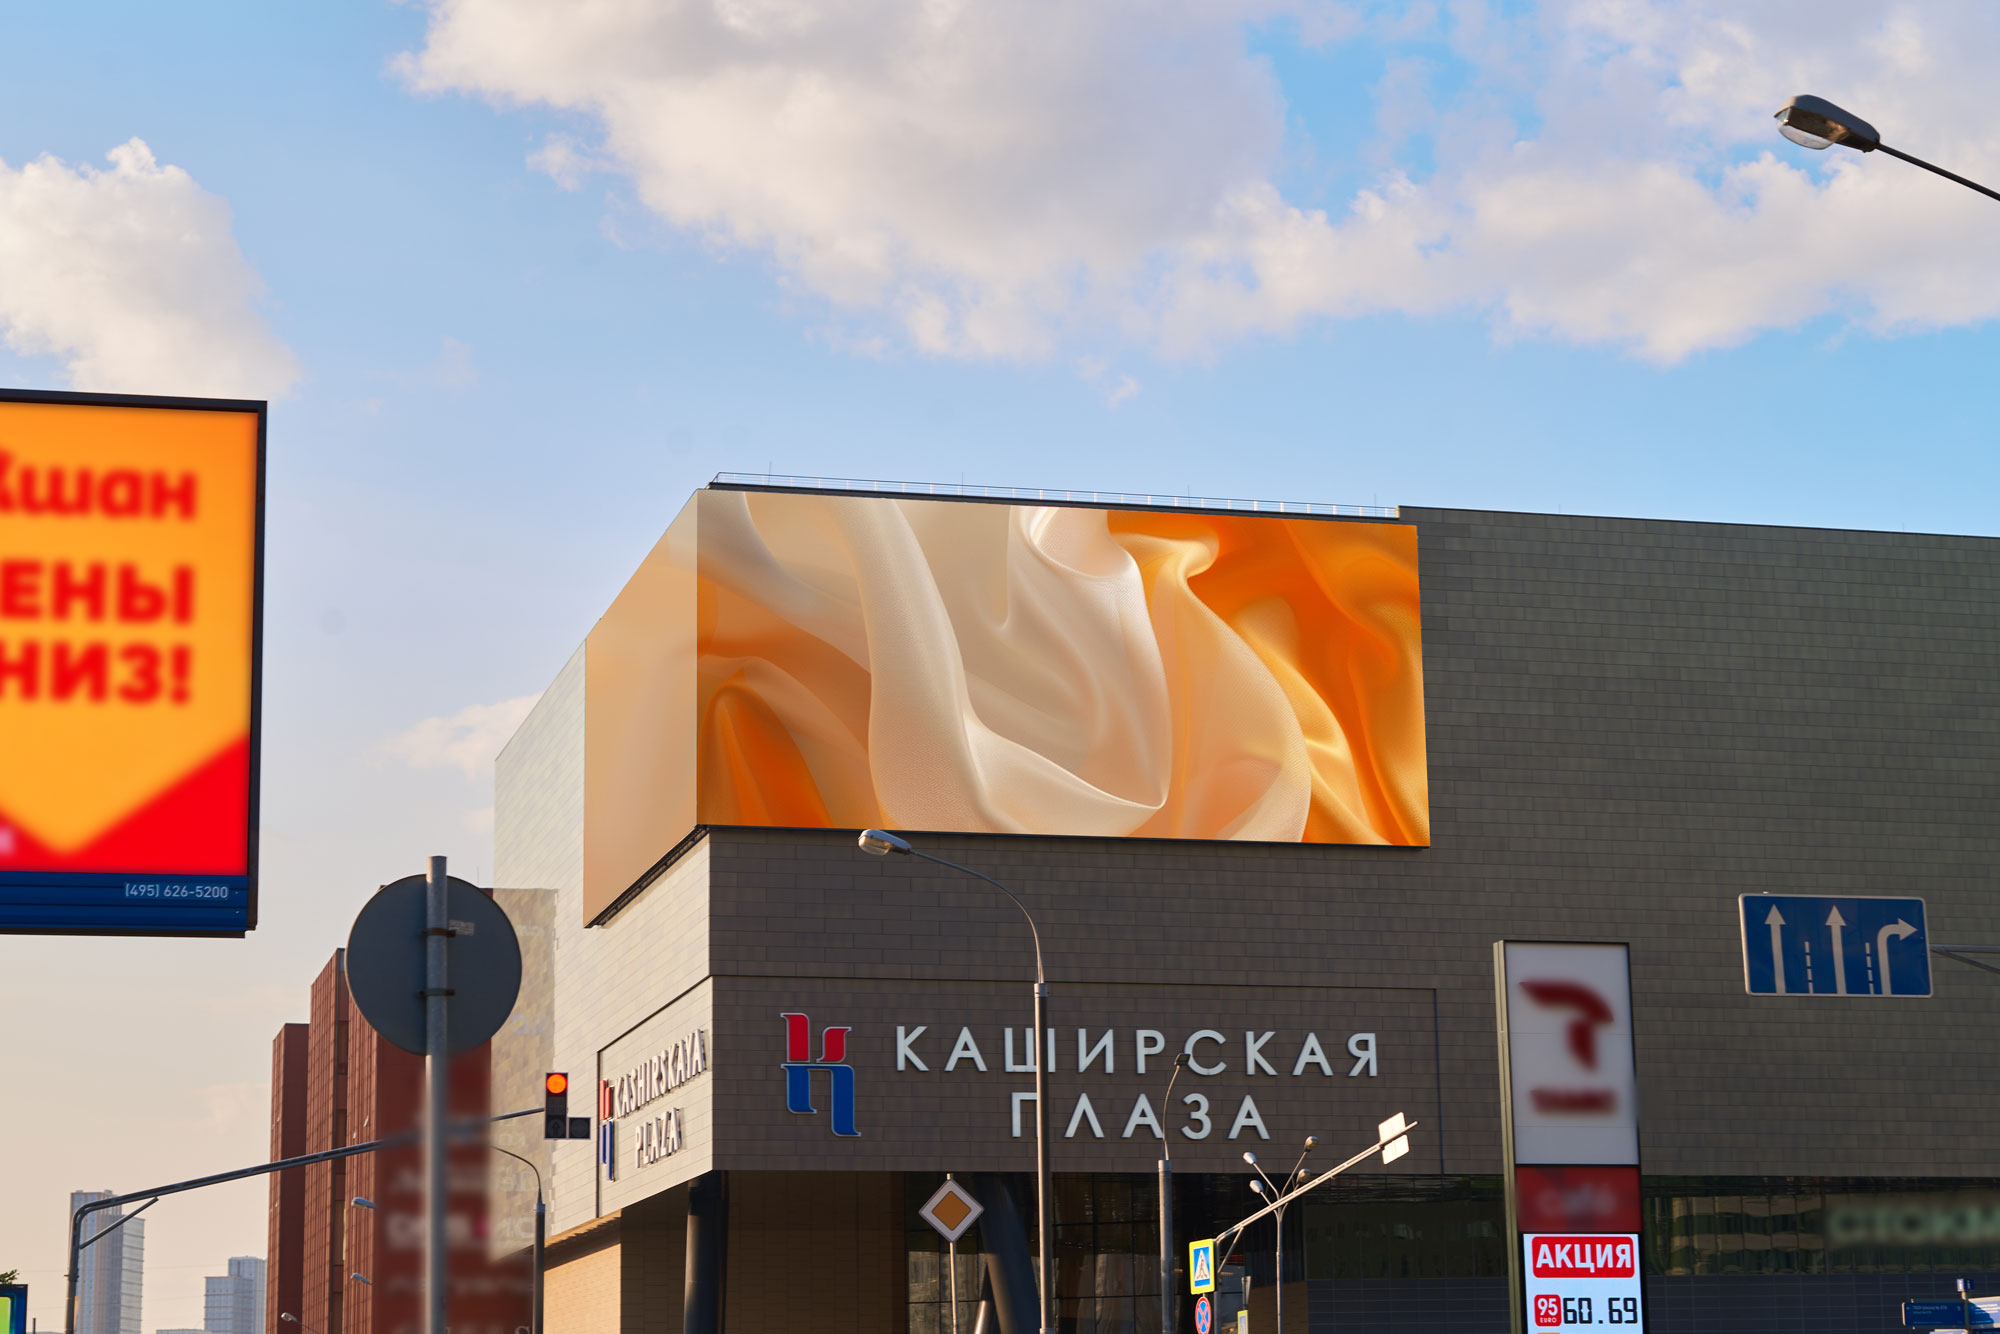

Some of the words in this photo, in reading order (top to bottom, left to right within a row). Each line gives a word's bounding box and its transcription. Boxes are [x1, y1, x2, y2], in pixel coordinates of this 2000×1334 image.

[163, 884, 228, 898] 626-5200
[895, 1026, 1378, 1077] КАШИРСКАЯ
[614, 1029, 707, 1119] KASHIRSKAYA
[635, 1107, 682, 1169] PLAZA
[1536, 1244, 1632, 1273] АКЦИЯ
[1537, 1298, 1558, 1317] 95
